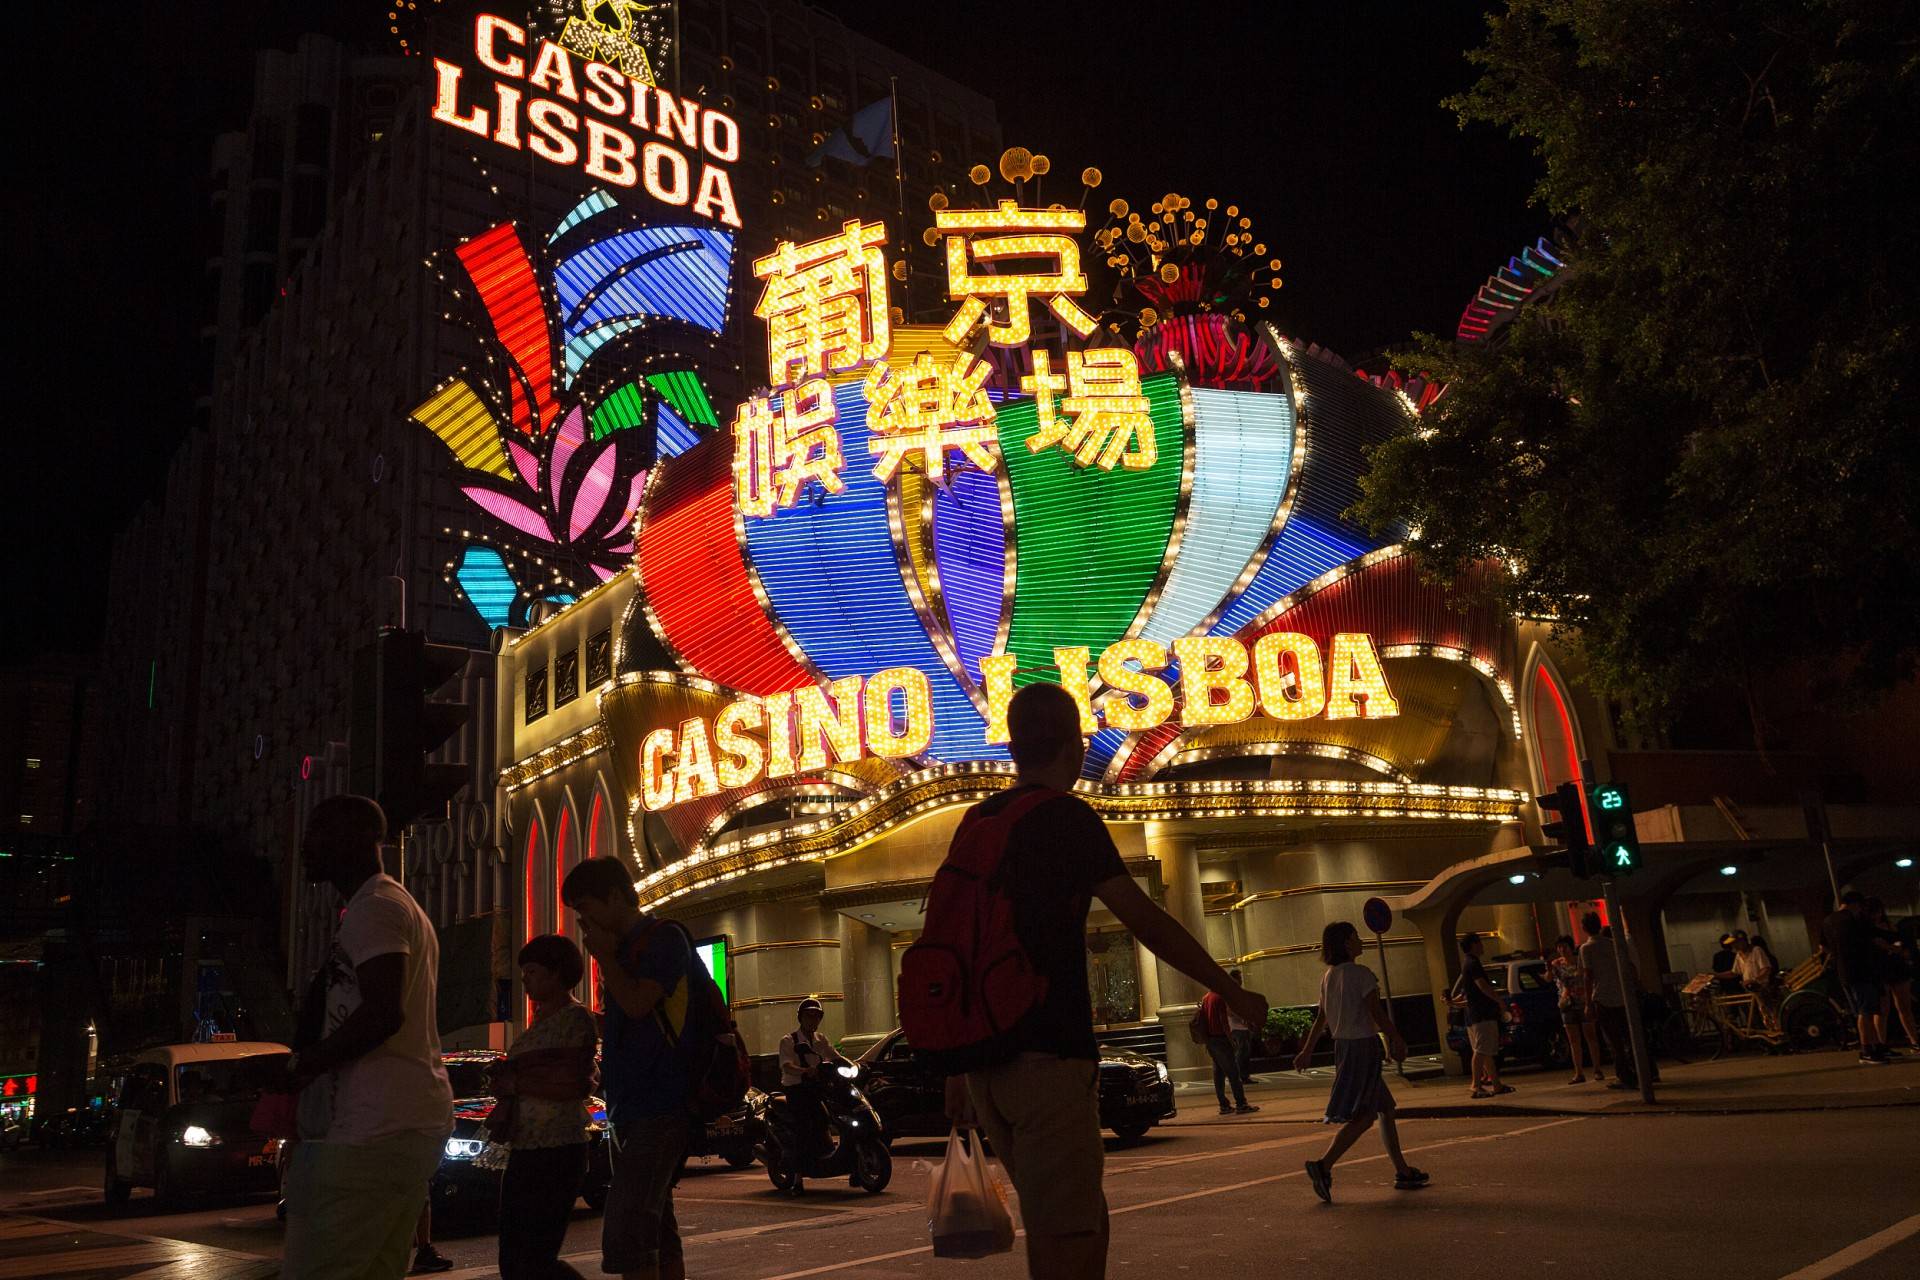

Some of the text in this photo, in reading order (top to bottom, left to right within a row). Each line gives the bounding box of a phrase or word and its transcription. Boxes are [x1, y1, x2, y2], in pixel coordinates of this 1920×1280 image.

[432, 58, 743, 229] LISBOA
[475, 13, 740, 163] CASINO
[753, 199, 1099, 387] 葡京
[640, 666, 934, 812] CASINO
[1601, 791, 1622, 809] 23
